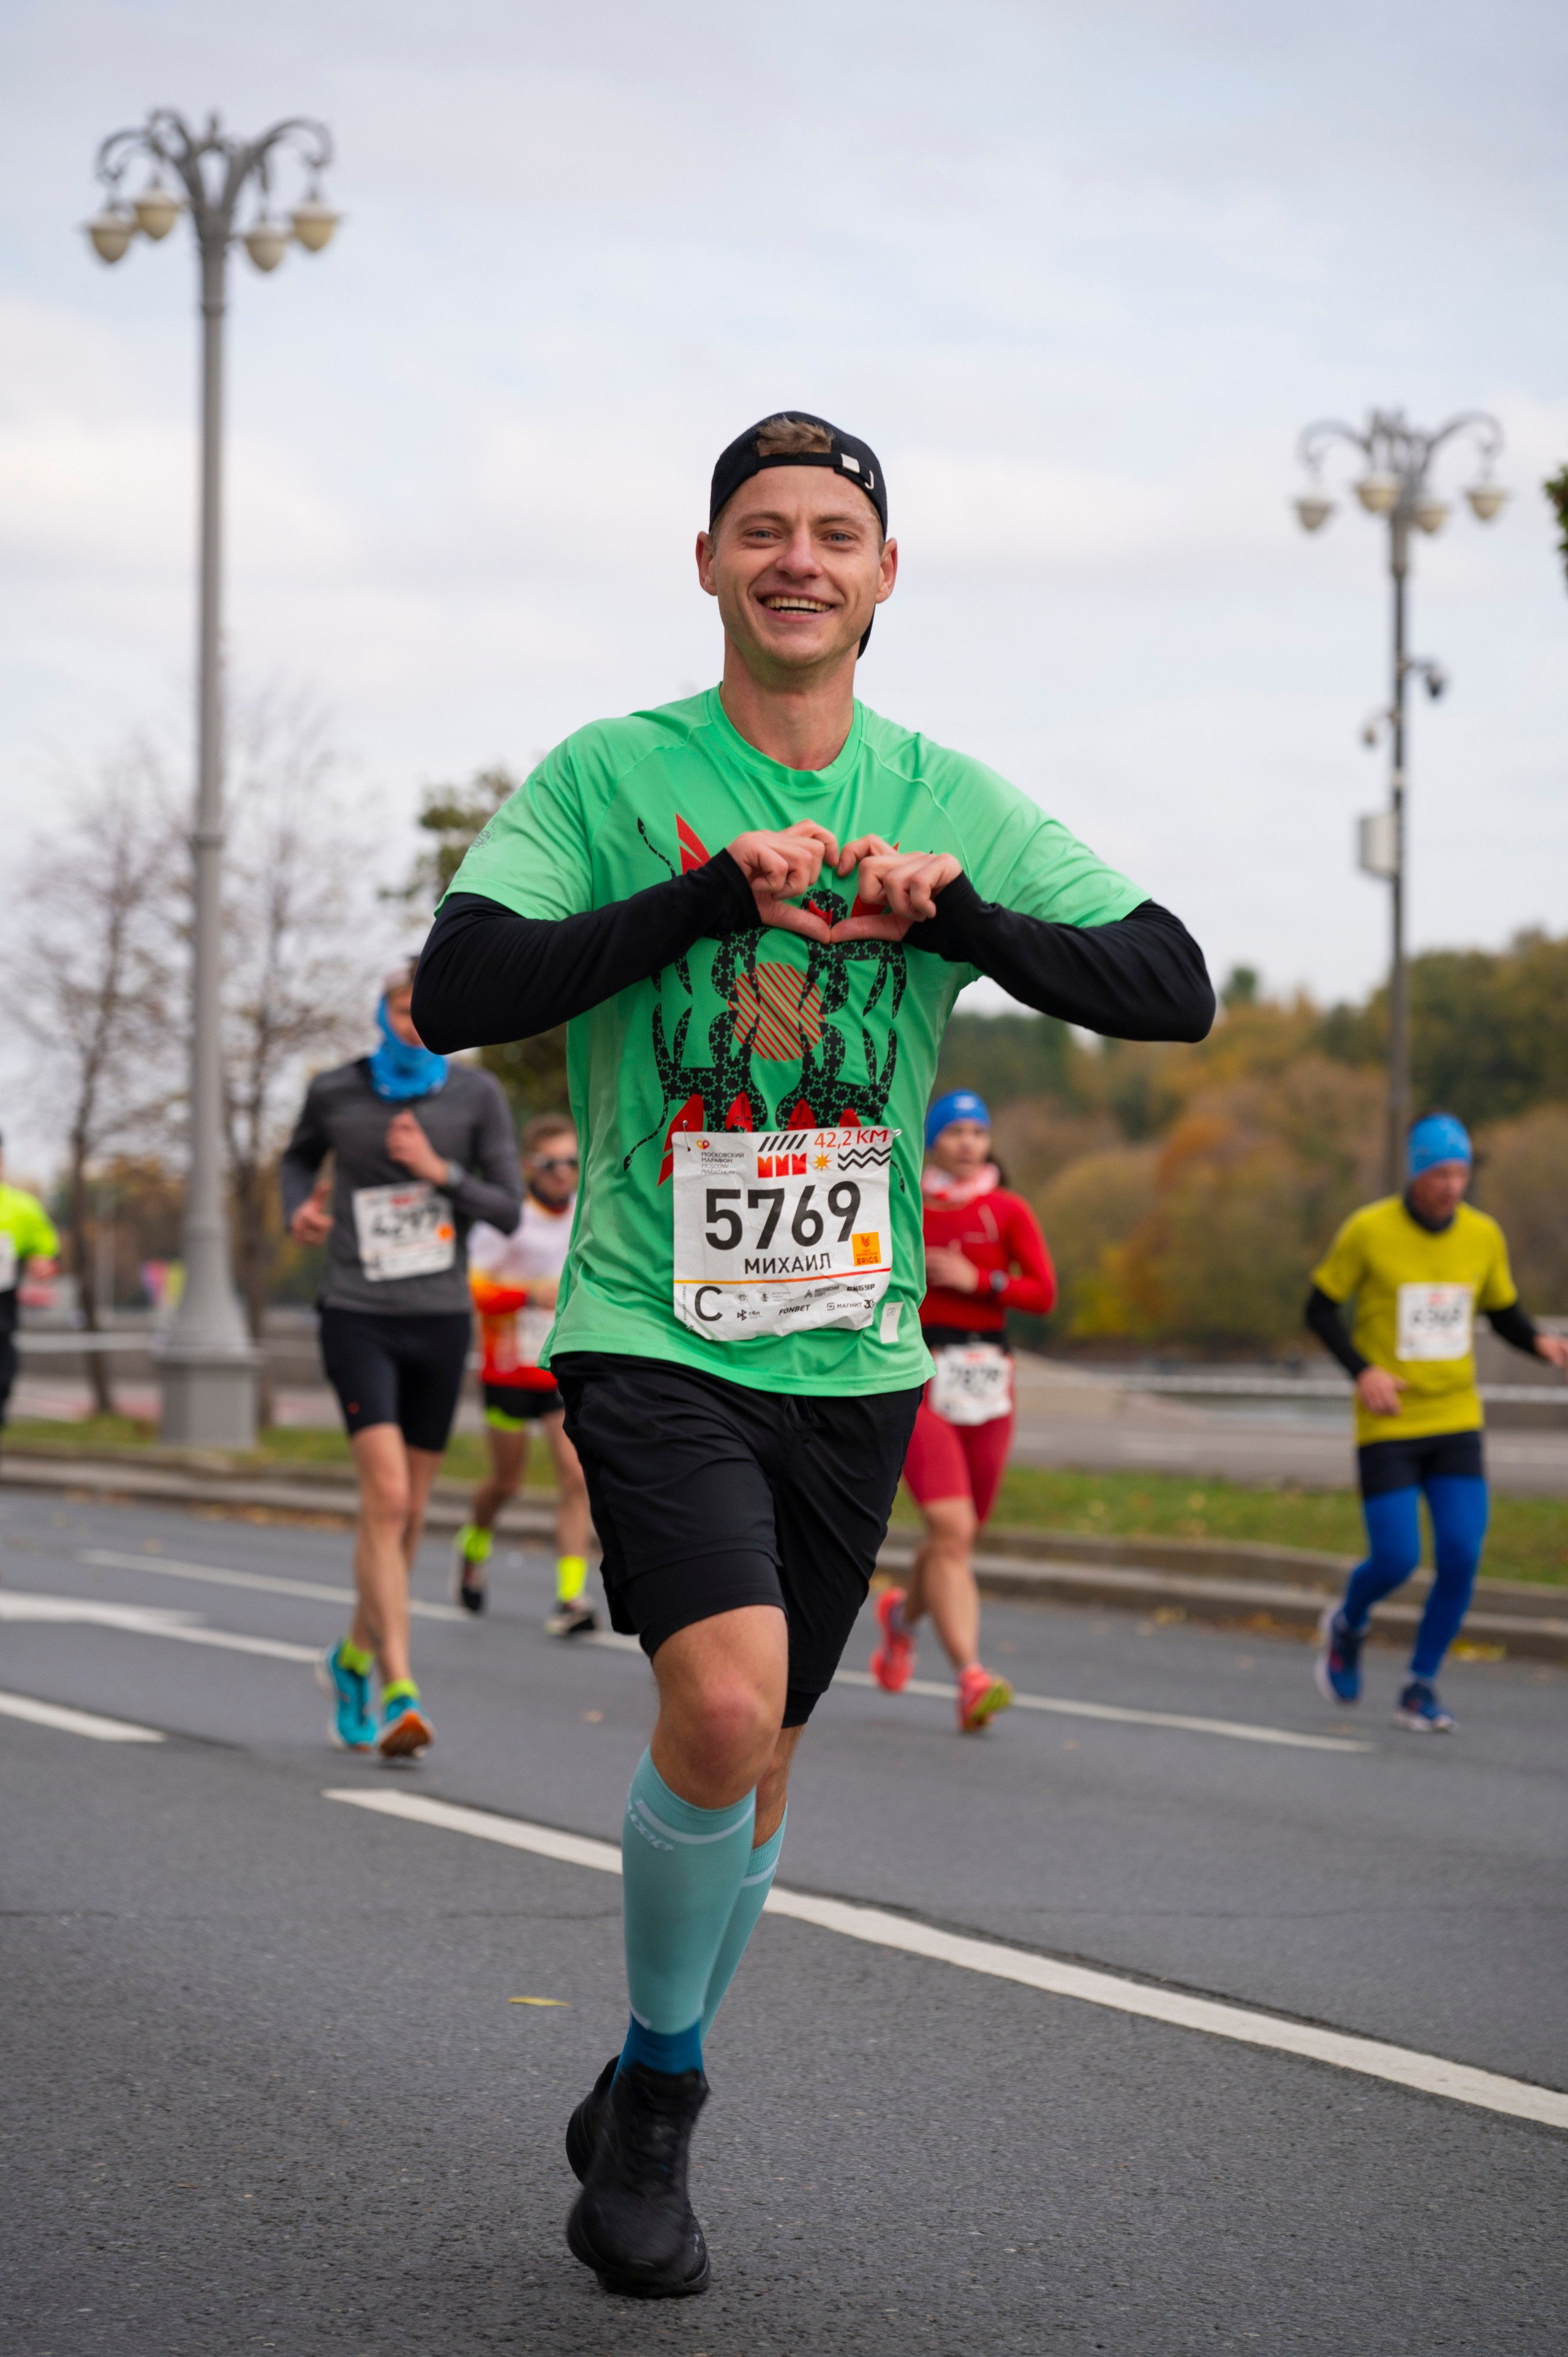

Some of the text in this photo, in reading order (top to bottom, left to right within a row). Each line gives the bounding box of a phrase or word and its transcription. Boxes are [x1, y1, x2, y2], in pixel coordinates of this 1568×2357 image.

[814, 1130, 852, 1149] 42,2
[705, 1180, 861, 1250] 5769
[745, 1253, 831, 1275] МИХАИЛ
[857, 1256, 878, 1264] BRICS
[778, 1304, 811, 1316] FONBET
